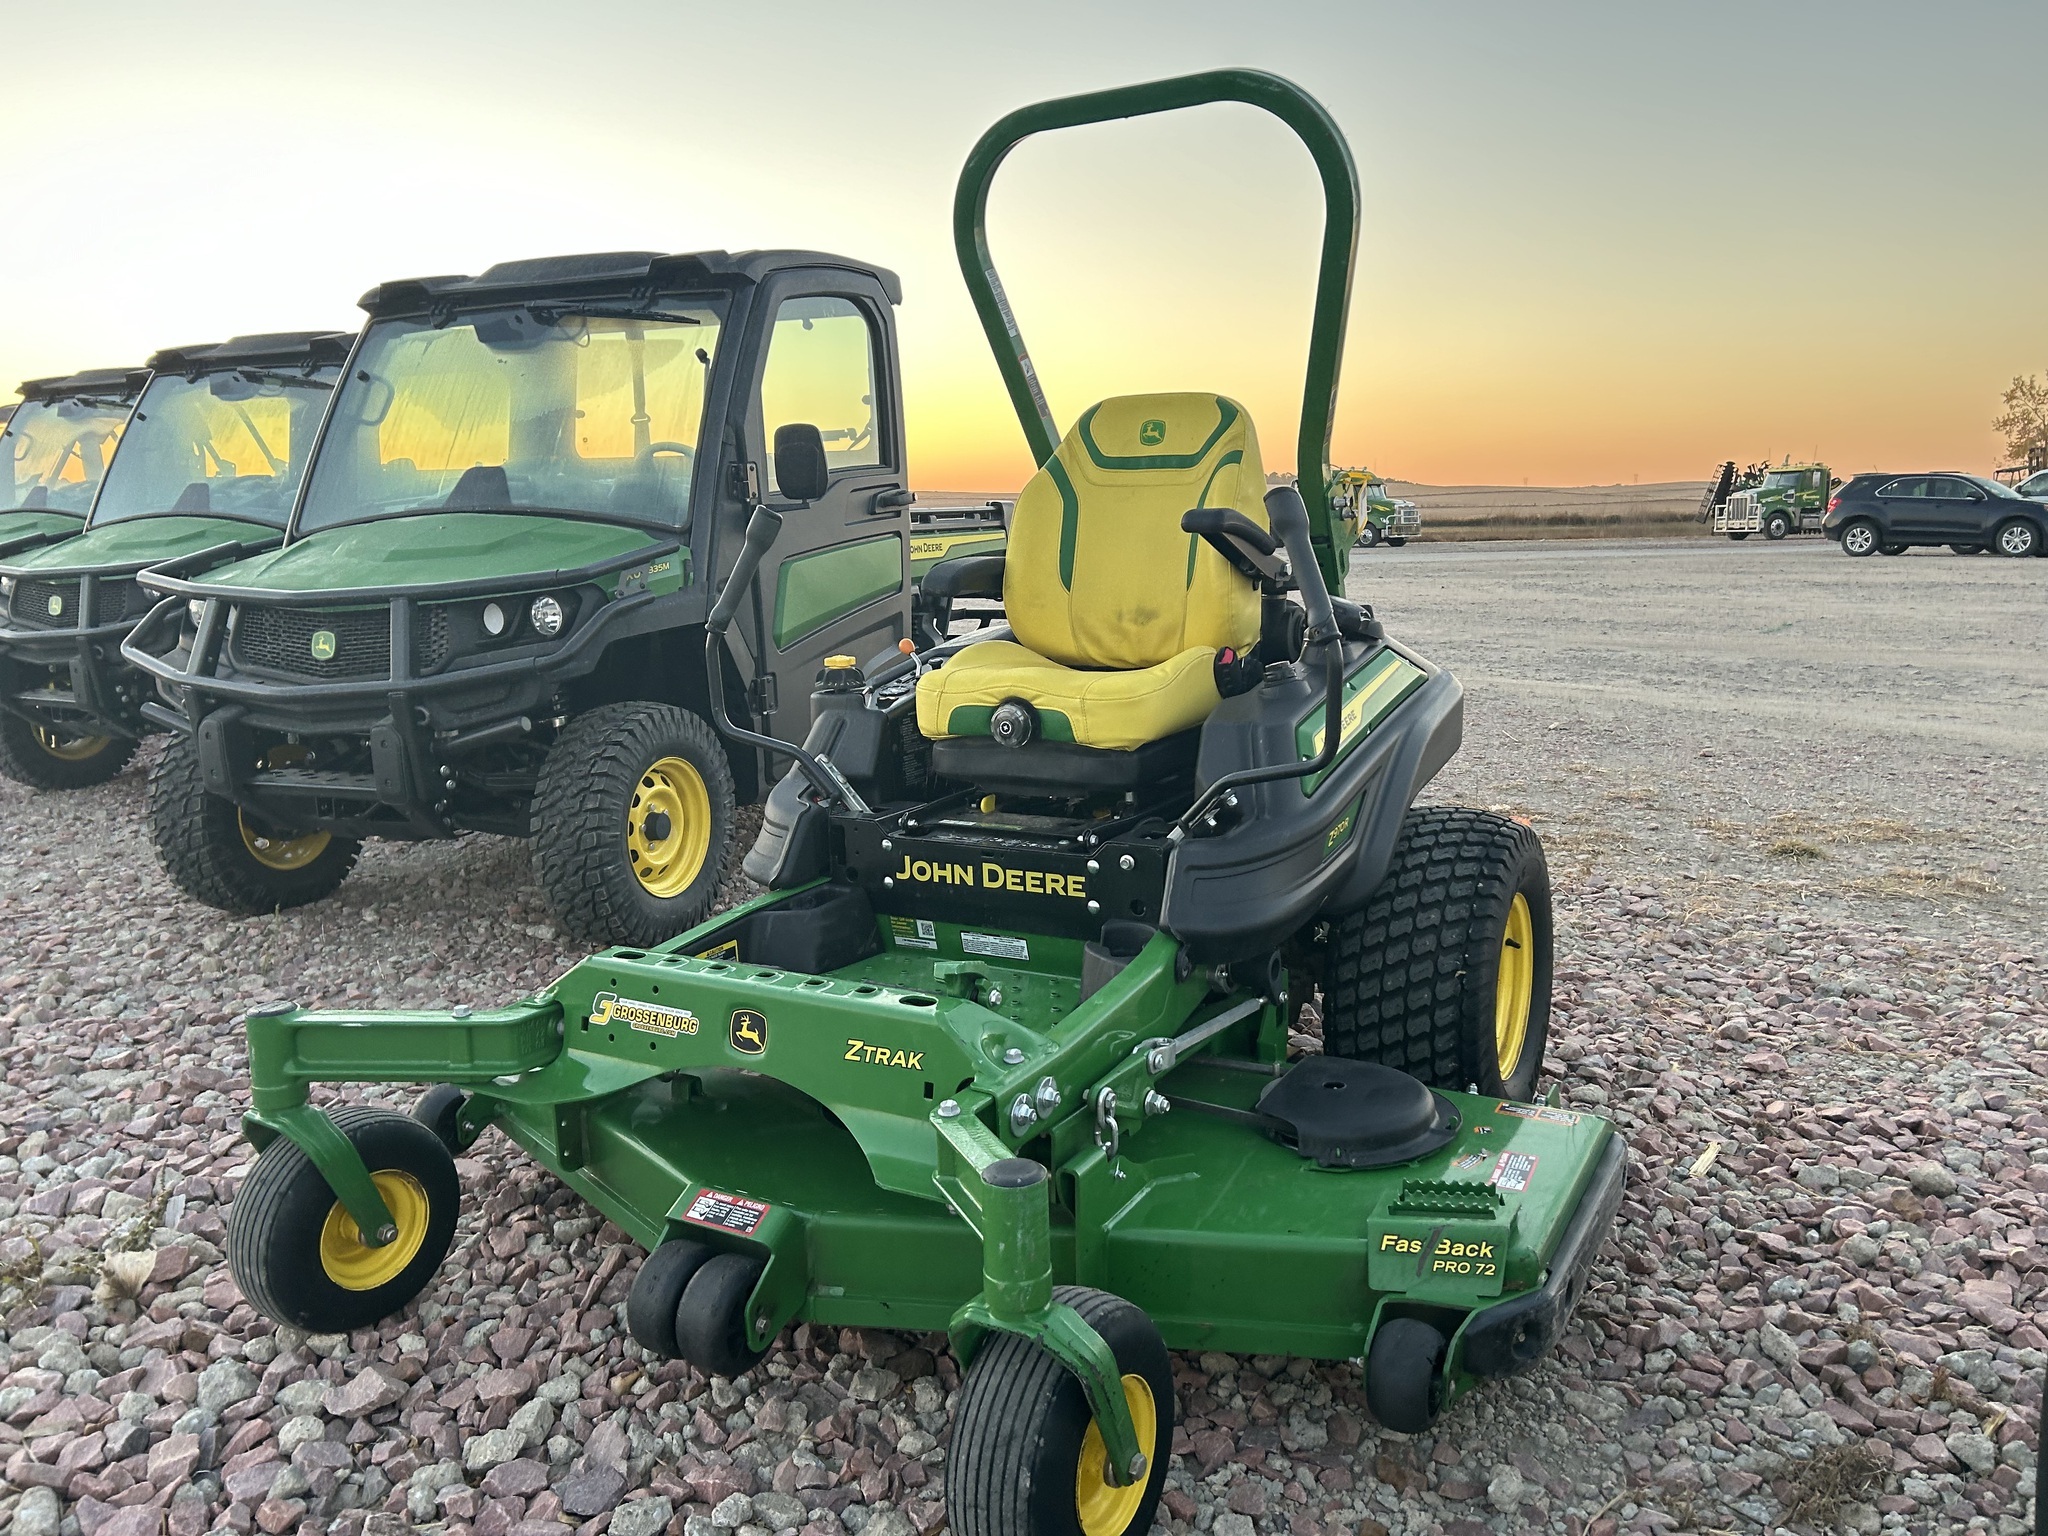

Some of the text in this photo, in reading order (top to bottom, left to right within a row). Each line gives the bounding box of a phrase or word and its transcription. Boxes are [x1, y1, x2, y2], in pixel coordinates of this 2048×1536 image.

[909, 543, 943, 554] OHN DEERE
[1341, 710, 1357, 730] EERE
[613, 1004, 698, 1034] GROSSENBURG
[713, 1192, 733, 1203] DANGER
[1432, 1260, 1496, 1275] PRO 72
